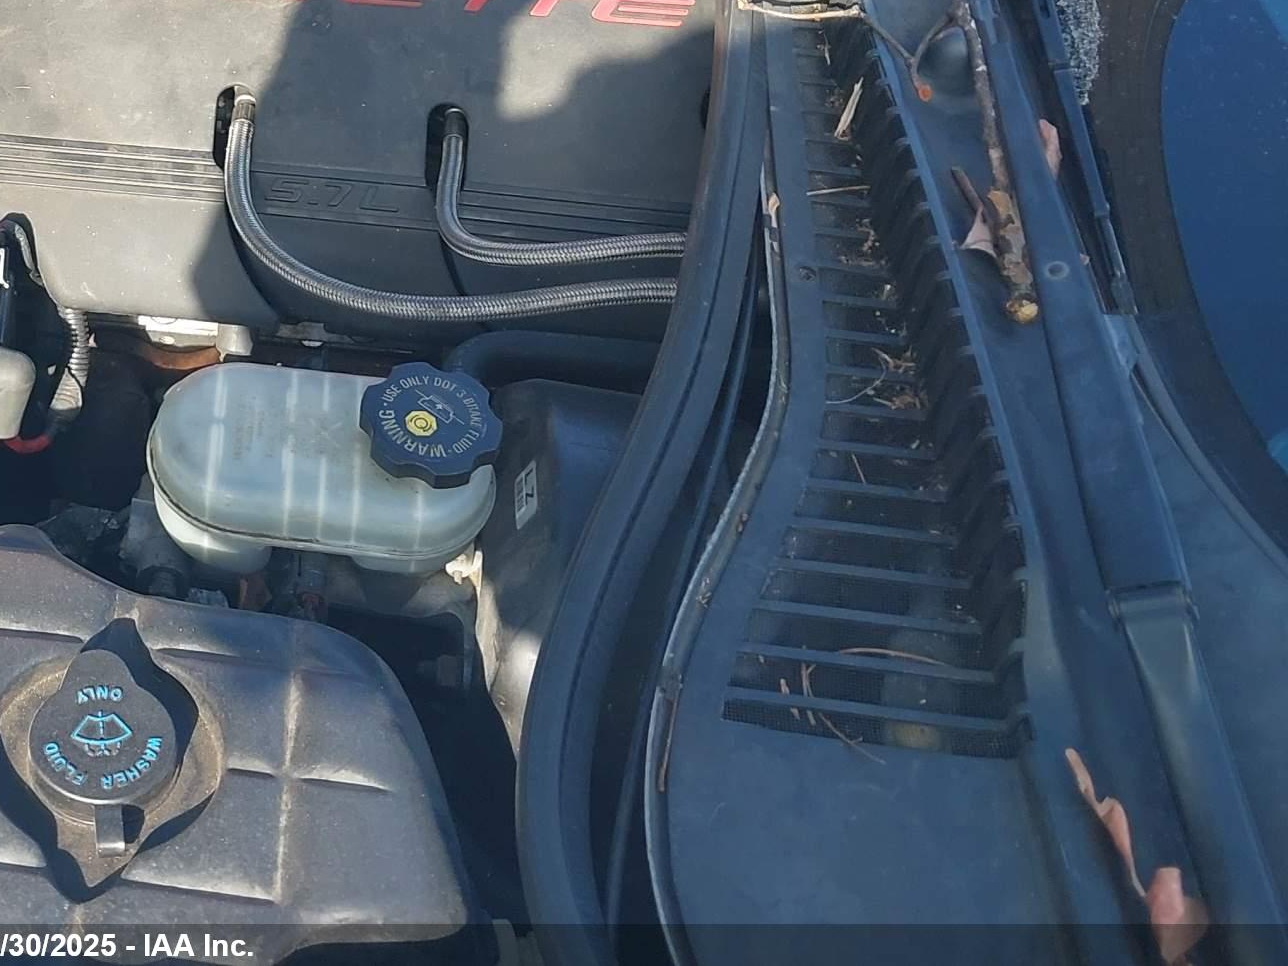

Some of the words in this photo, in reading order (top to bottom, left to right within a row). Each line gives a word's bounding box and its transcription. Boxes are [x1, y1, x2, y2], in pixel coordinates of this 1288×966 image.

[265, 178, 399, 213] 5.7L
[381, 384, 402, 403] USE
[399, 375, 430, 389] ONLY
[433, 377, 457, 392] DOT
[456, 388, 466, 398] 3
[462, 394, 483, 428] BRAKE
[378, 409, 447, 458] WARNING
[452, 429, 481, 454] FLUID
[76, 685, 124, 705] ONLY
[43, 741, 88, 786] FLUID
[100, 736, 163, 790] WASHER
